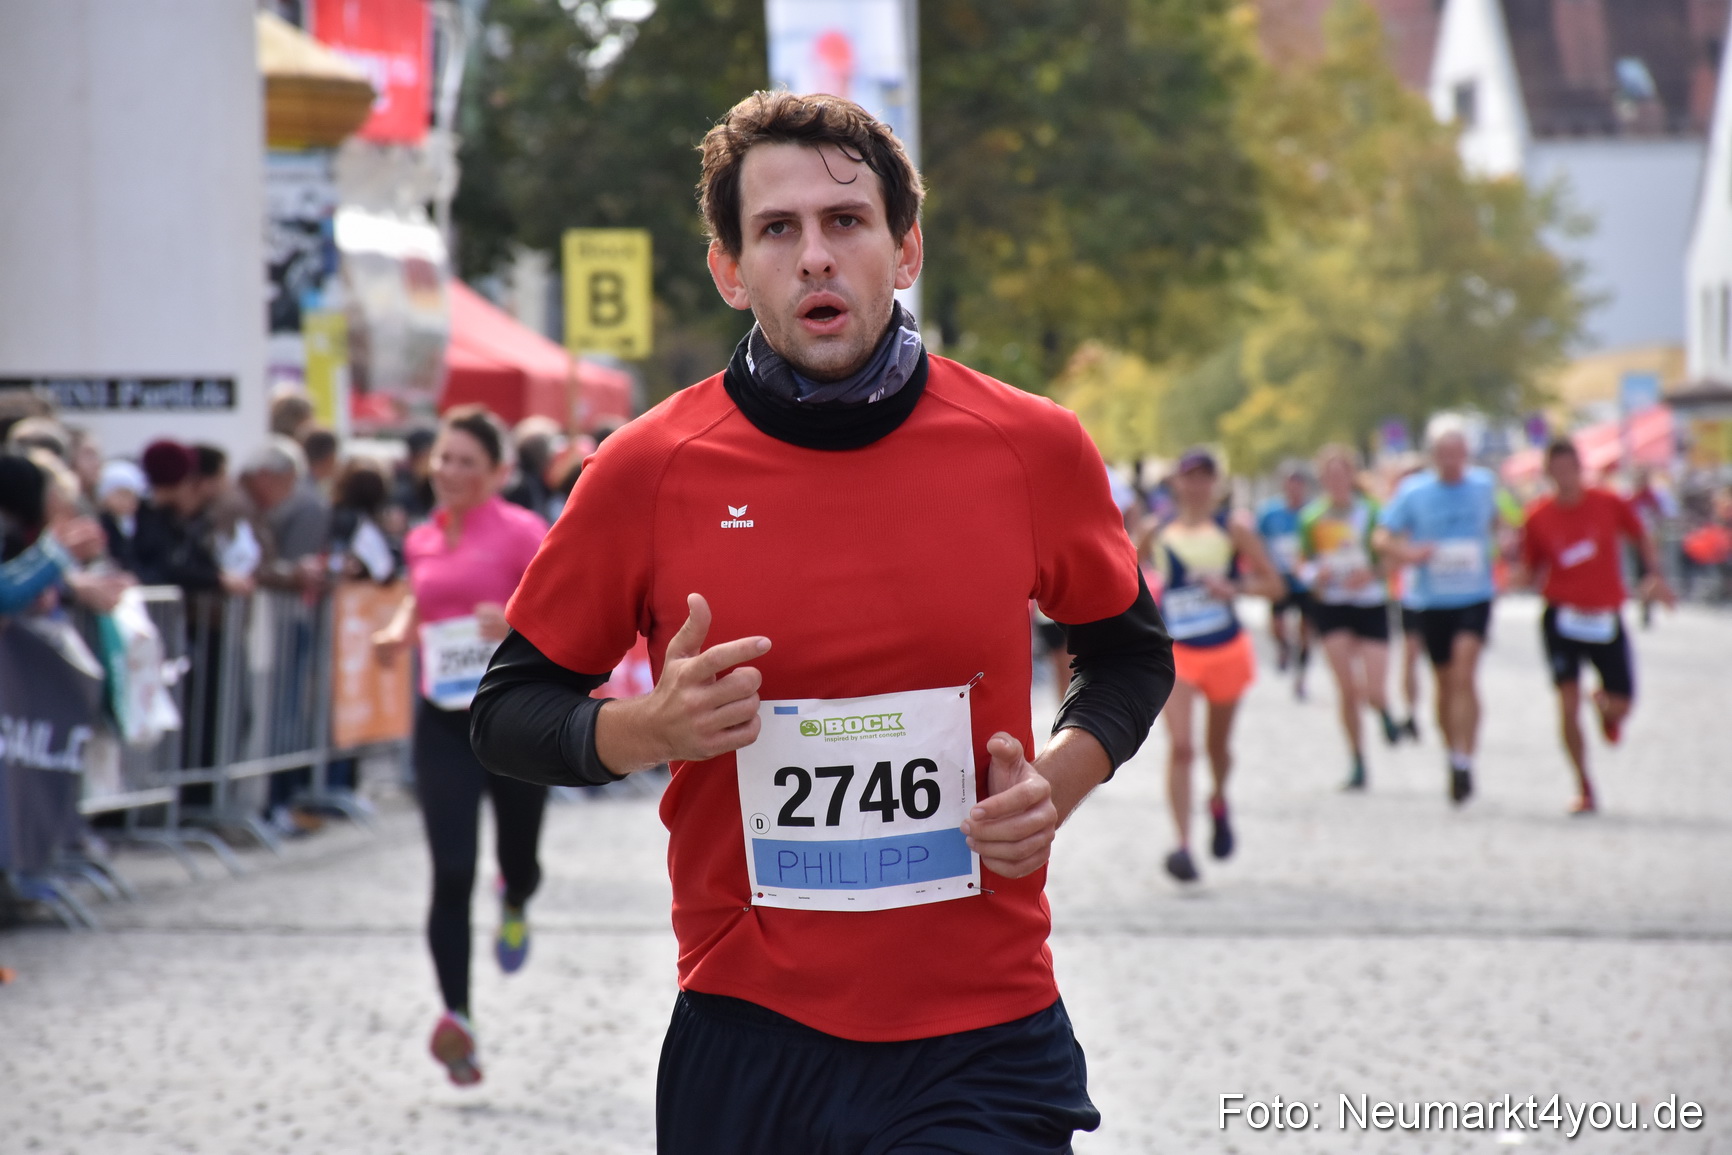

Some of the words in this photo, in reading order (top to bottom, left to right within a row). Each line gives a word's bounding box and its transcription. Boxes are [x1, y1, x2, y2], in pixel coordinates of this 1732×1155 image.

[588, 271, 629, 329] B
[720, 518, 754, 529] erima
[823, 712, 905, 736] BOCK
[878, 731, 907, 739] concepts
[773, 757, 941, 827] 2746
[755, 818, 764, 830] D
[777, 845, 930, 885] PHILIPP
